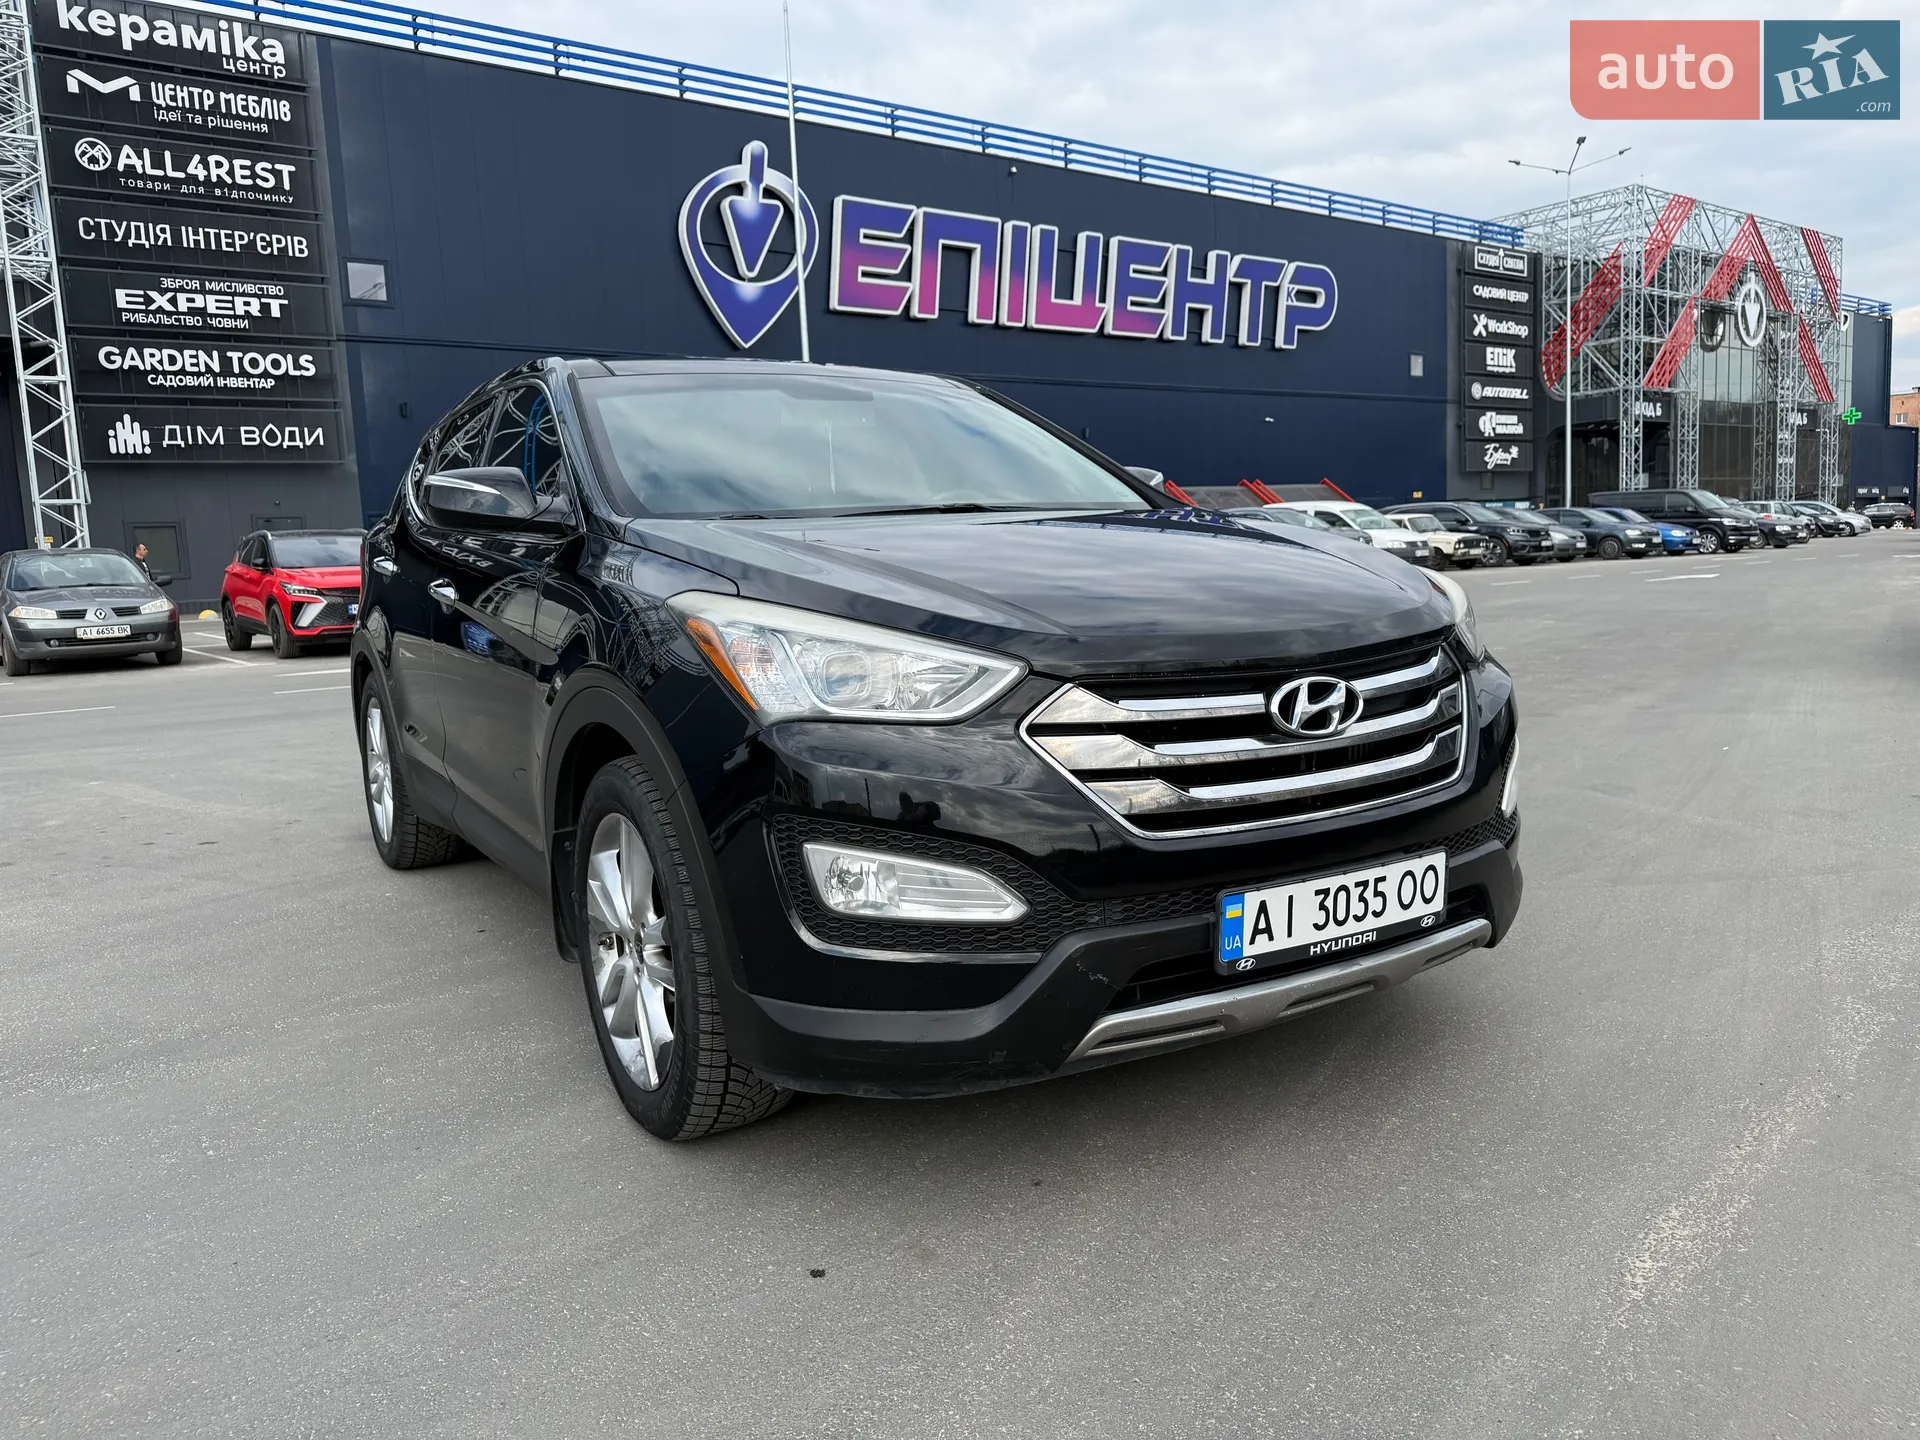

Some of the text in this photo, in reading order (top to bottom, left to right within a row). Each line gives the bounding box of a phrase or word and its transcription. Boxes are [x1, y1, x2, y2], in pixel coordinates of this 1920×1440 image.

[223, 56, 287, 80] центр
[150, 81, 292, 123] ЦЕНТР МЕБЛІВ
[153, 106, 269, 134] ідеї та рішення
[117, 143, 296, 192] ALL4REST
[119, 177, 295, 204] товари для відпочинку
[77, 216, 309, 259] СТУДІЯ ІНТЕР'ЄРІВ
[829, 194, 1339, 350] ЕПІЦЕНТР
[160, 277, 285, 296] ЗБРОЯ МИСЛИВСТВО
[114, 287, 289, 319] EXPERT
[121, 311, 250, 330] РИБАЛЬСТВО ЧОВНИ
[98, 345, 317, 378] GARDEN TOOLS
[147, 373, 276, 390] САДОВИЙ ІНВЕНТАР
[162, 422, 325, 450] ДІМ ВОДИ
[96, 626, 115, 636] 6655
[117, 626, 129, 635] BK
[1248, 863, 1440, 946] AI 3035 OO
[1224, 936, 1241, 951] UA
[1309, 930, 1377, 956] HYUNDAI
